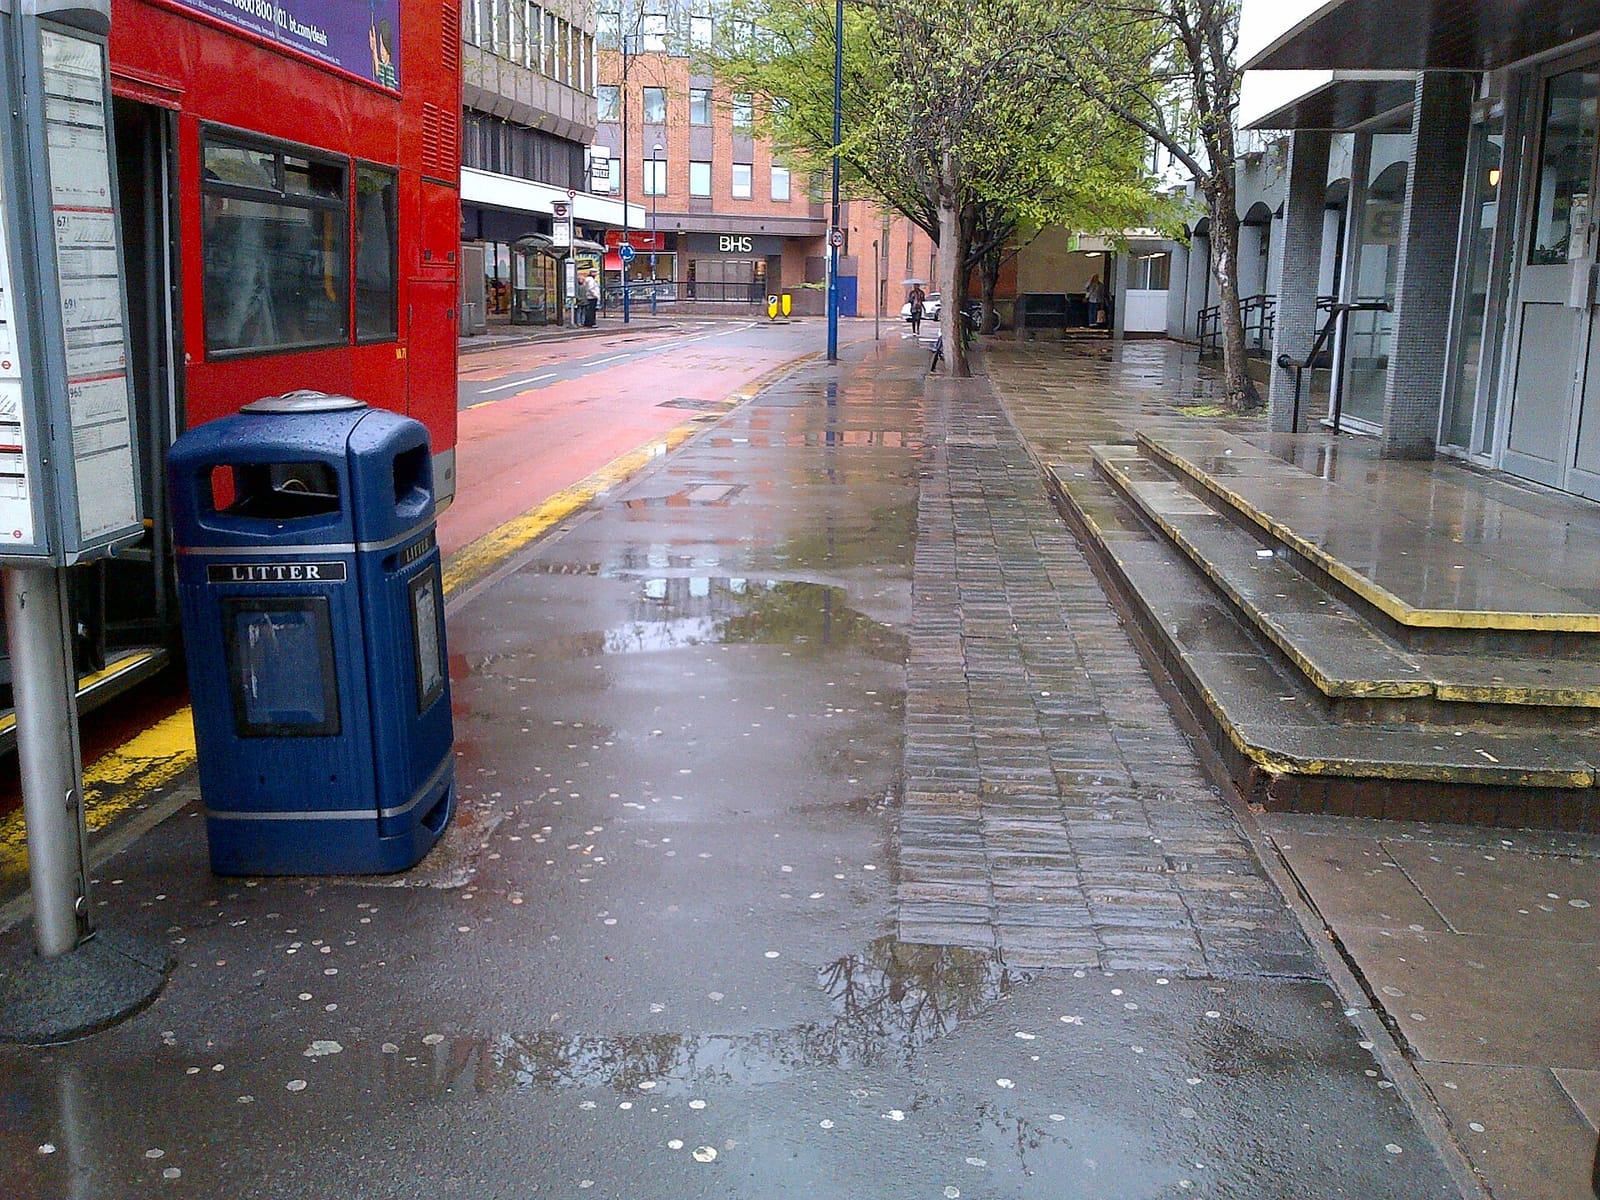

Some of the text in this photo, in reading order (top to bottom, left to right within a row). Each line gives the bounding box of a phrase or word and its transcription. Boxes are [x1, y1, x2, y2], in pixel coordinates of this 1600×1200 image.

[256, 2, 273, 22] 800
[289, 14, 328, 47] bt.com/deals
[719, 235, 753, 252] BHS
[406, 541, 429, 562] LITTER
[231, 565, 321, 580] LITTER
